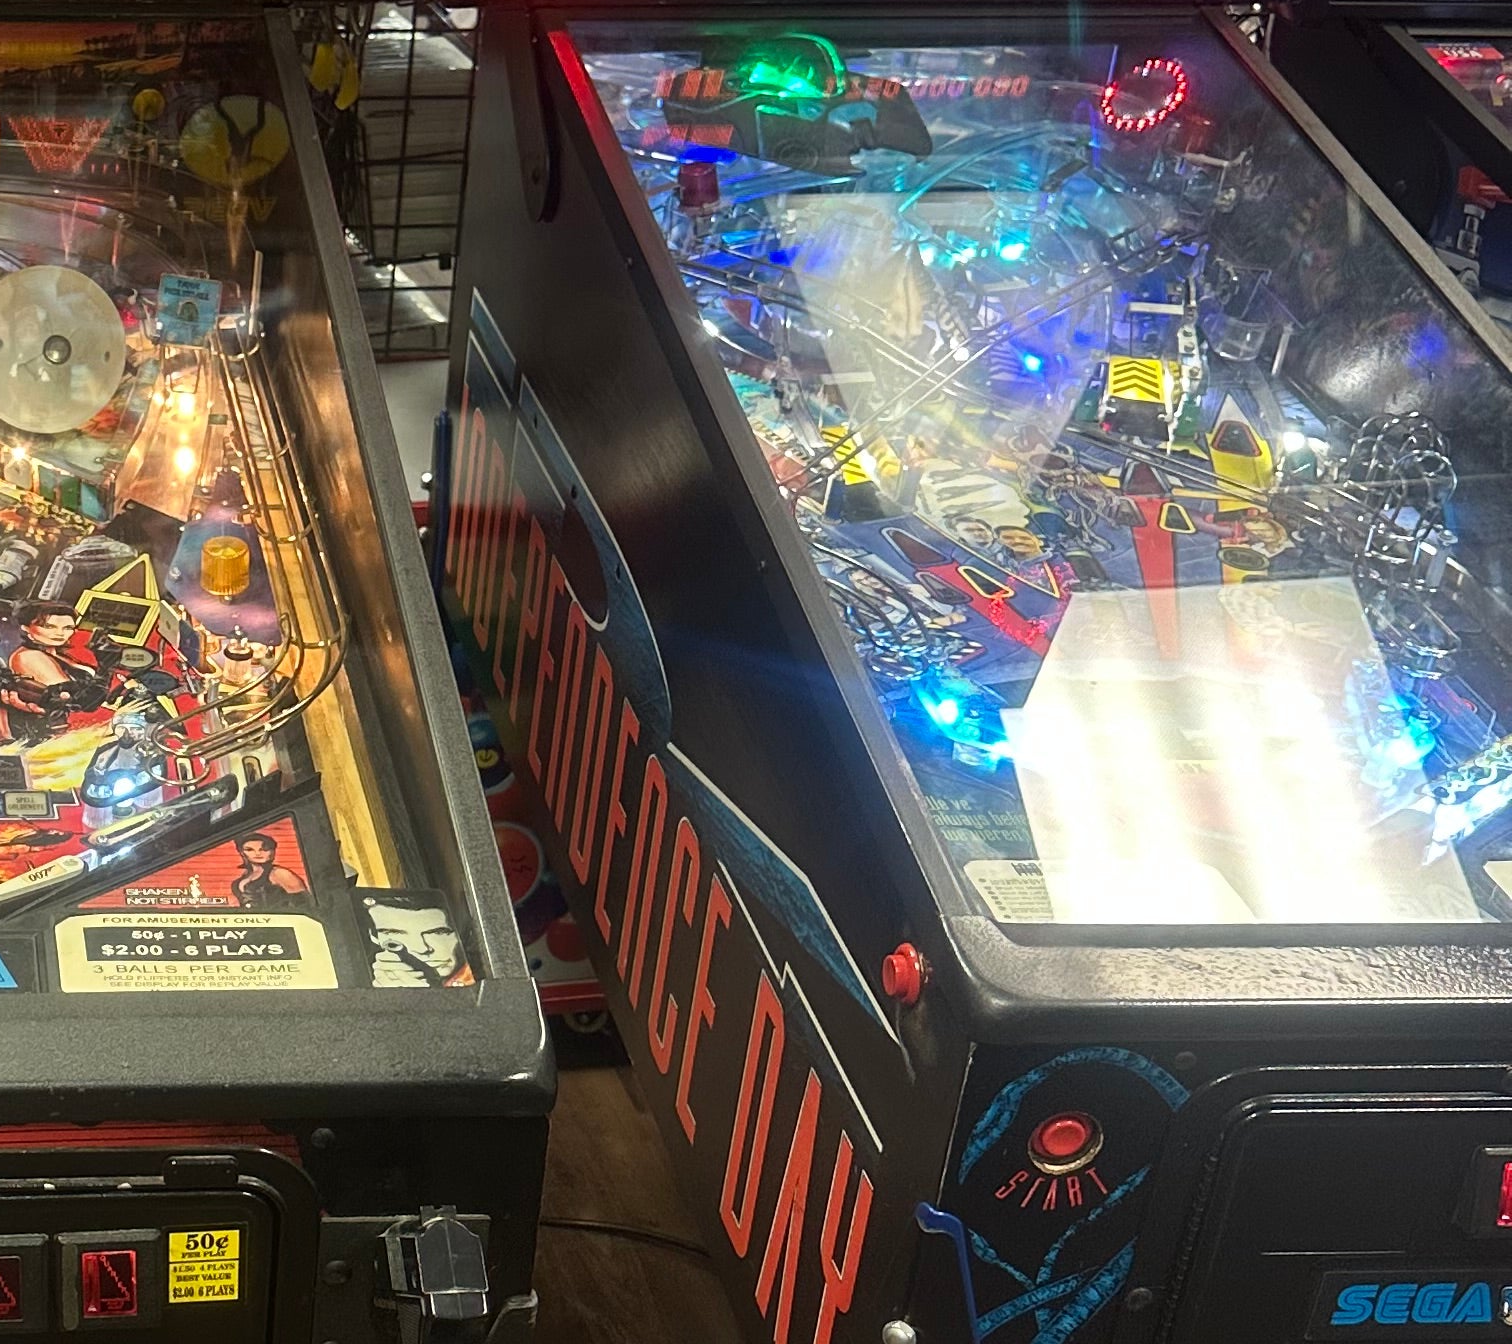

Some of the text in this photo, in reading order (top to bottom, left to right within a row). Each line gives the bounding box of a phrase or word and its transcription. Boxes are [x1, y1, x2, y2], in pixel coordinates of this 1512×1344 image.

[445, 383, 732, 1145] INDEPENDENCE
[28, 865, 52, 882] 007
[126, 896, 157, 905] NOT
[131, 930, 165, 940] 50¢
[182, 931, 191, 939] 1
[199, 930, 248, 939] PLAY
[101, 944, 163, 956] $2.00
[184, 945, 199, 955] 6
[206, 944, 284, 956] PLAYS
[93, 964, 300, 974] 3 BALLS PER GAME
[994, 1167, 1108, 1211] START
[185, 1233, 230, 1251] 50¢
[203, 1250, 227, 1258] PLAY
[207, 1263, 236, 1271] PLAYS
[175, 1273, 232, 1282] BEST VALUE
[172, 1284, 235, 1299] $2.00 6 PLAYS
[1329, 1282, 1493, 1325] SEGA
